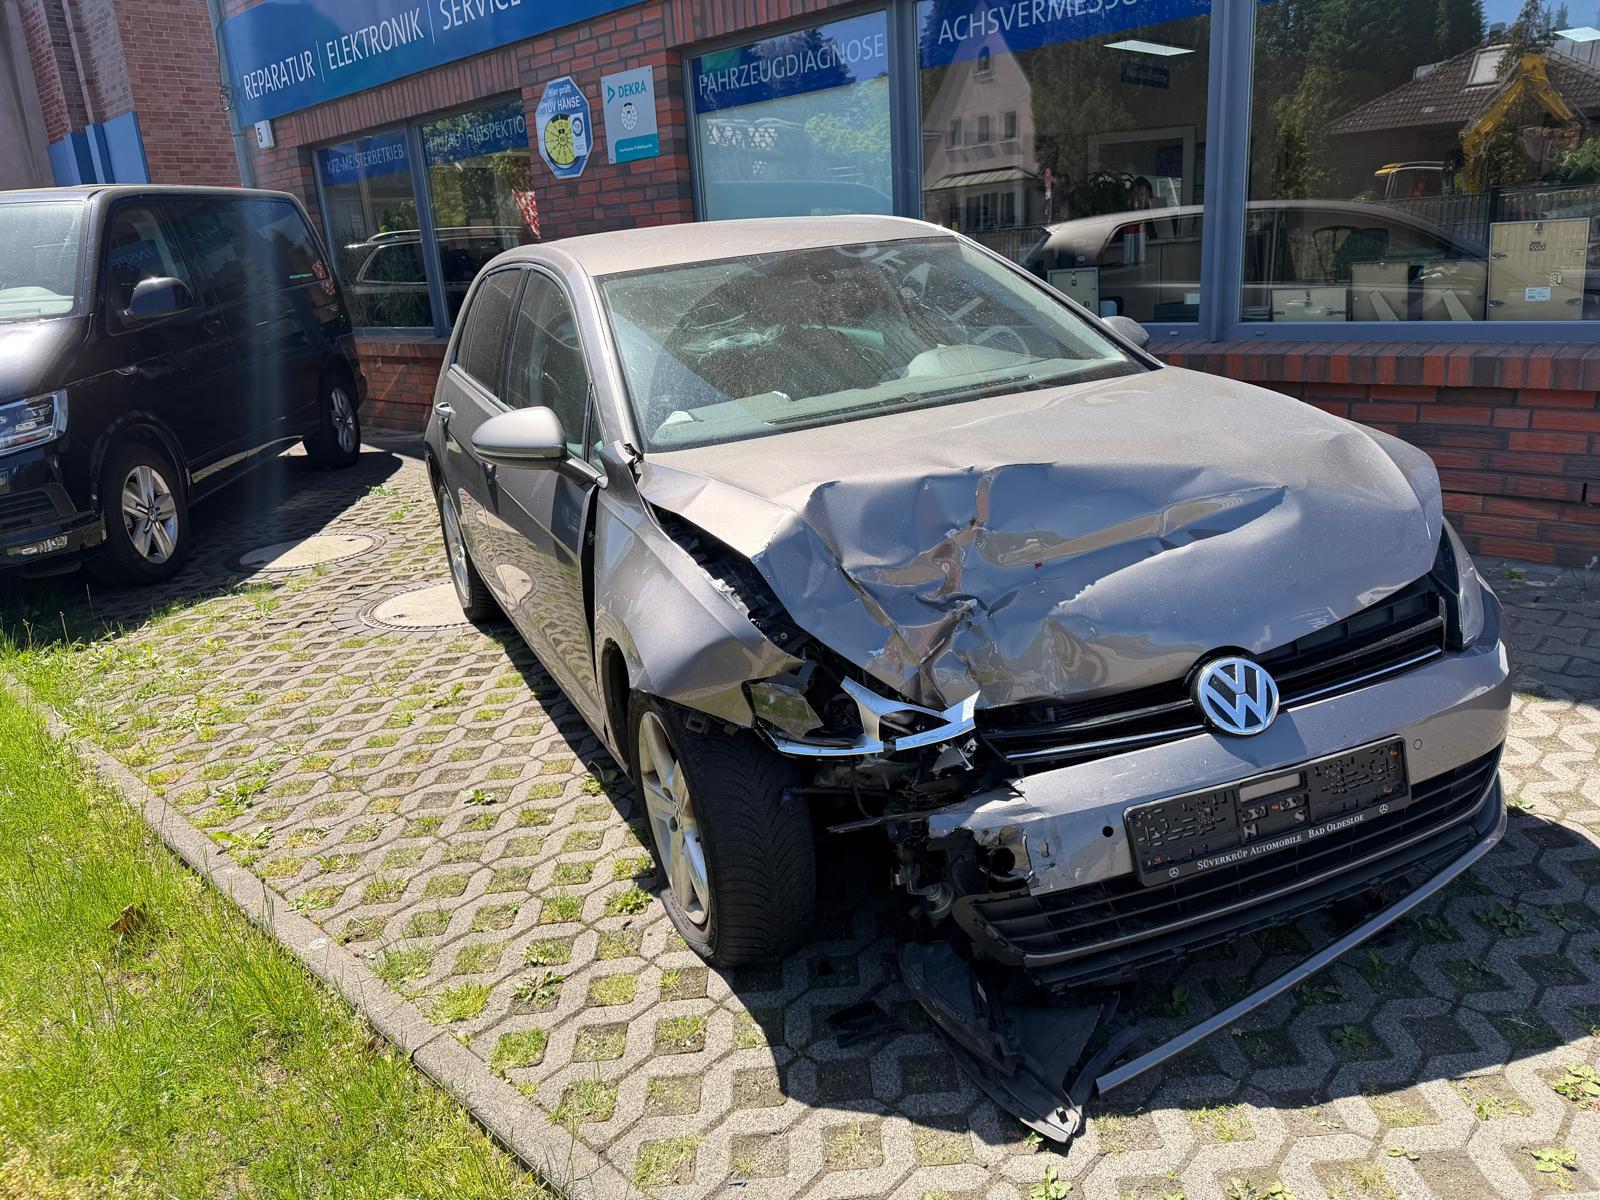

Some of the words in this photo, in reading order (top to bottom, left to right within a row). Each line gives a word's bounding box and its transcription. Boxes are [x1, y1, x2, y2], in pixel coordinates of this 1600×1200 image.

[243, 50, 316, 100] REPARATUR
[327, 8, 424, 70] ELEKTRONIK
[699, 33, 884, 96] FAHRZEUGDIAGNOSE
[618, 80, 647, 98] DEKRA
[544, 99, 557, 113] TÜV
[557, 96, 580, 110] HANSE
[256, 127, 264, 143] 5
[327, 143, 404, 175] KFZ-MEISTERBETRIEB
[1197, 849, 1248, 870] SÜVERKRÜP
